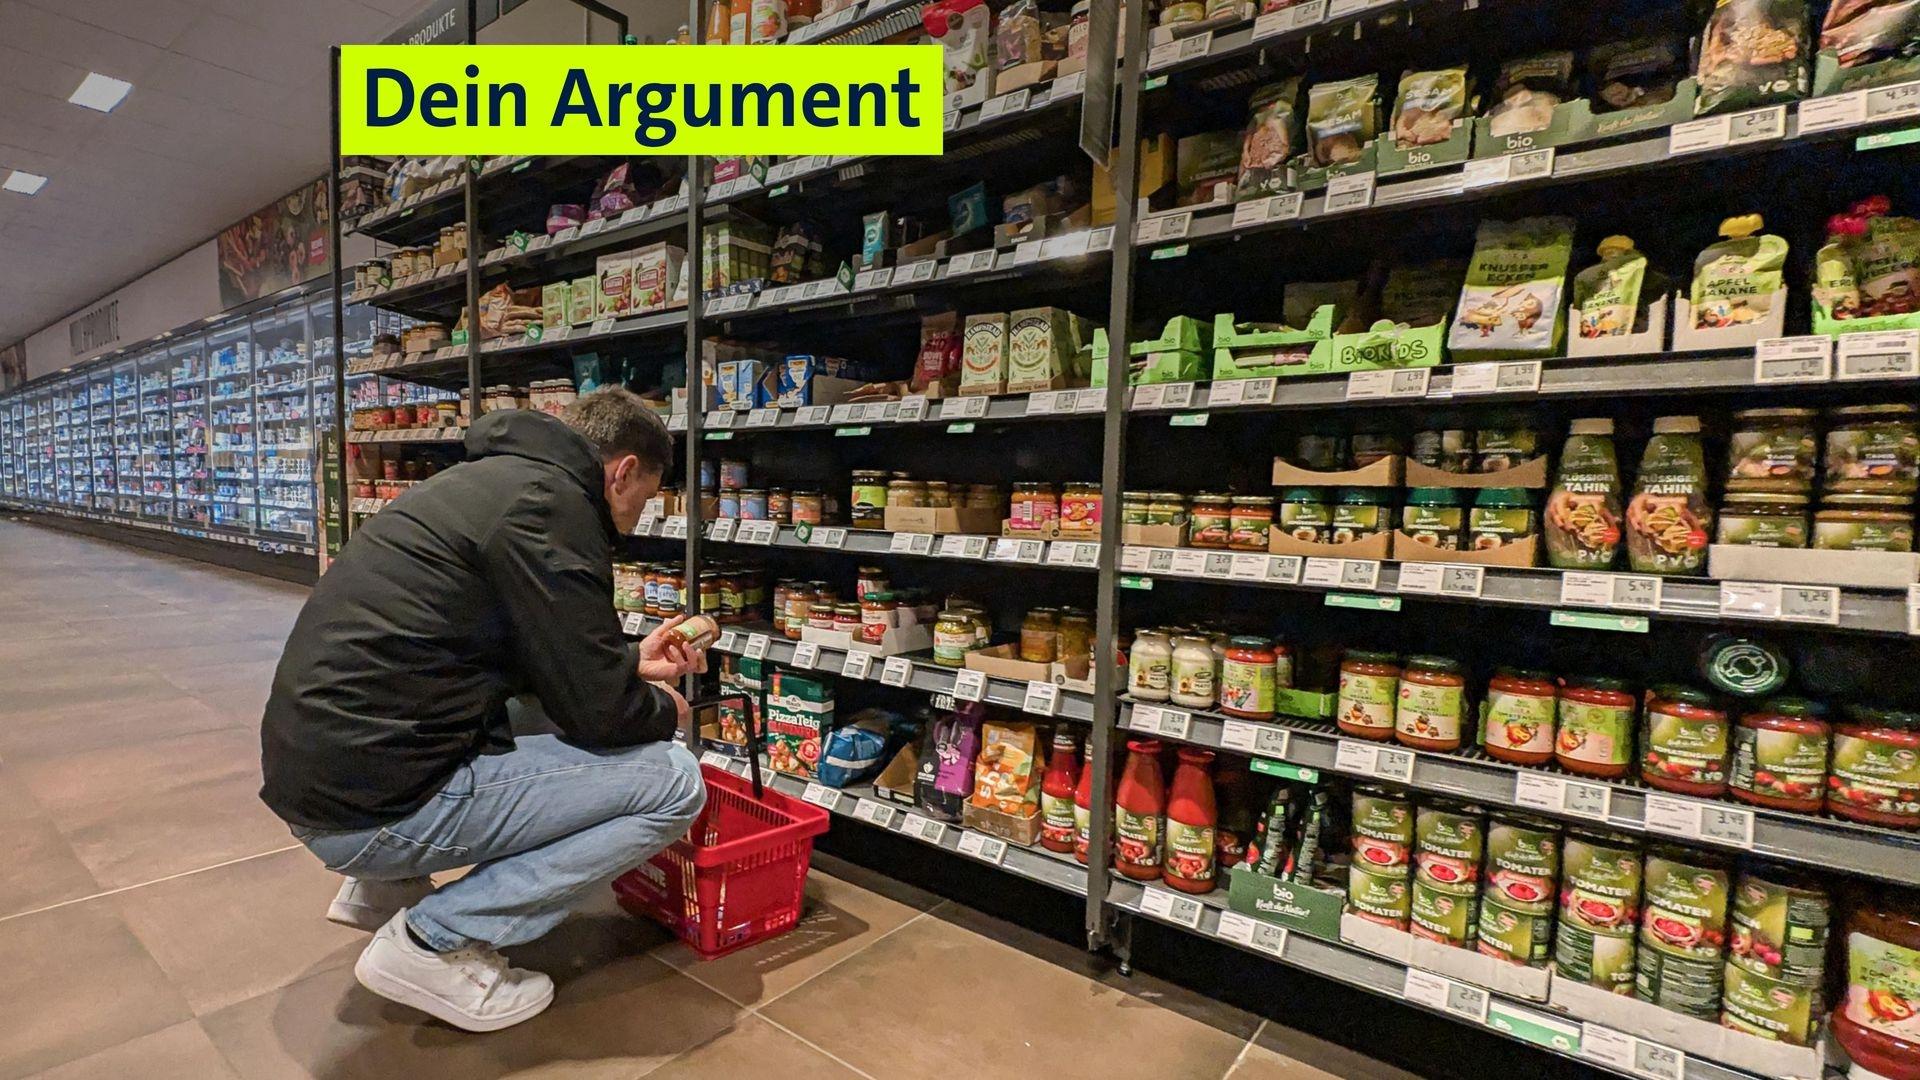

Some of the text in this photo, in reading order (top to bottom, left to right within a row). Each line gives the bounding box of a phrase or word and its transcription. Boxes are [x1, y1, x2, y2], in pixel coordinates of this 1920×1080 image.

[408, 8, 456, 46] PRODUKTE
[1507, 135, 1533, 150] bio
[1408, 152, 1431, 164] bio
[1479, 262, 1549, 272] KNUSPER
[1487, 272, 1536, 282] ECKEN
[1707, 278, 1750, 288] APFEL
[965, 322, 1002, 341] HAMPSTEAD
[1011, 317, 1050, 337] HAMPSTEAD
[1566, 482, 1610, 493] TAHIN
[1644, 483, 1693, 494] TAHIN
[768, 709, 820, 730] PizzaTeig
[1371, 806, 1388, 817] bio
[1355, 825, 1405, 841] TOMATEN
[1437, 821, 1455, 833] bio
[1172, 843, 1206, 853] TOMATEN
[1420, 840, 1472, 859] TOMATEN
[1517, 839, 1536, 850] bio
[1496, 859, 1552, 875] TOMATEN
[1592, 858, 1612, 868] bio
[1273, 884, 1294, 899] bio
[1369, 882, 1386, 893] bio
[1570, 876, 1631, 896] TOMATEN
[1354, 899, 1403, 917] TOMATEN
